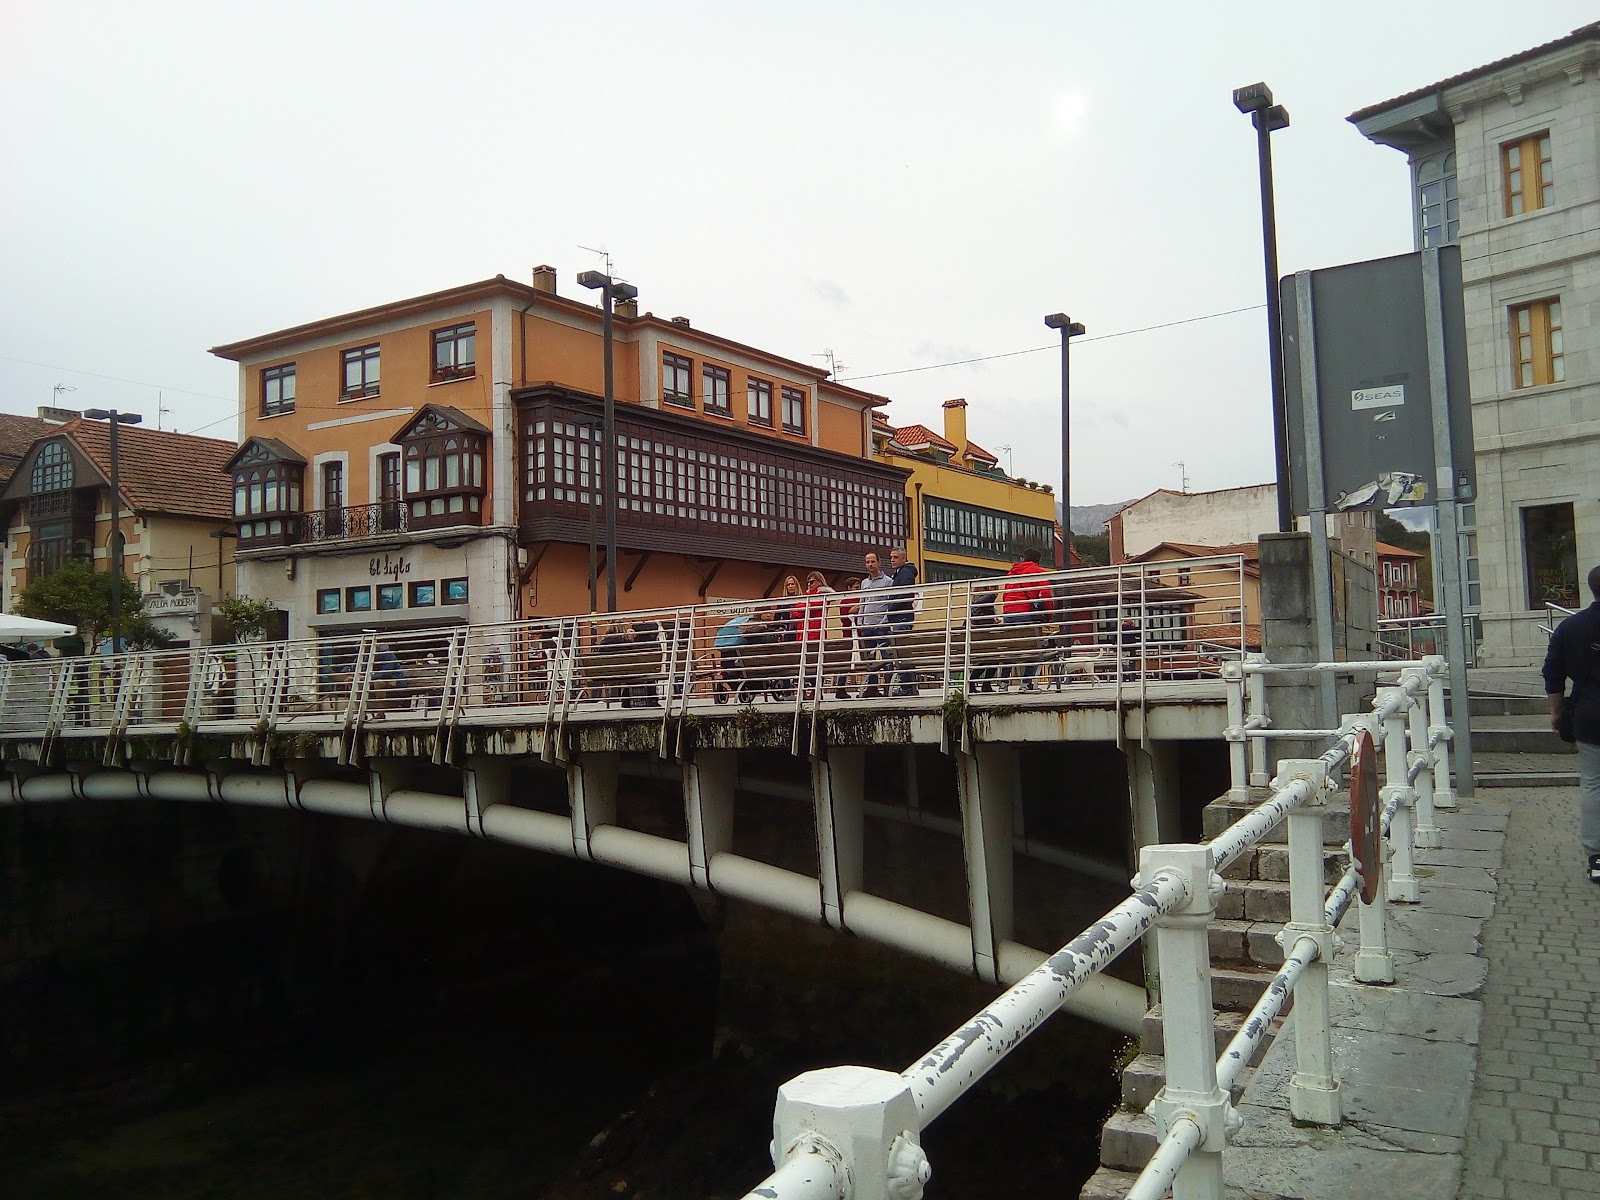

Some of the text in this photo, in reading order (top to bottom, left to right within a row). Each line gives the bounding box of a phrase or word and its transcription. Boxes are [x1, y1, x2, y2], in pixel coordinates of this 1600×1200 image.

[1364, 390, 1402, 401] SEAS
[369, 554, 411, 581] El Siglo
